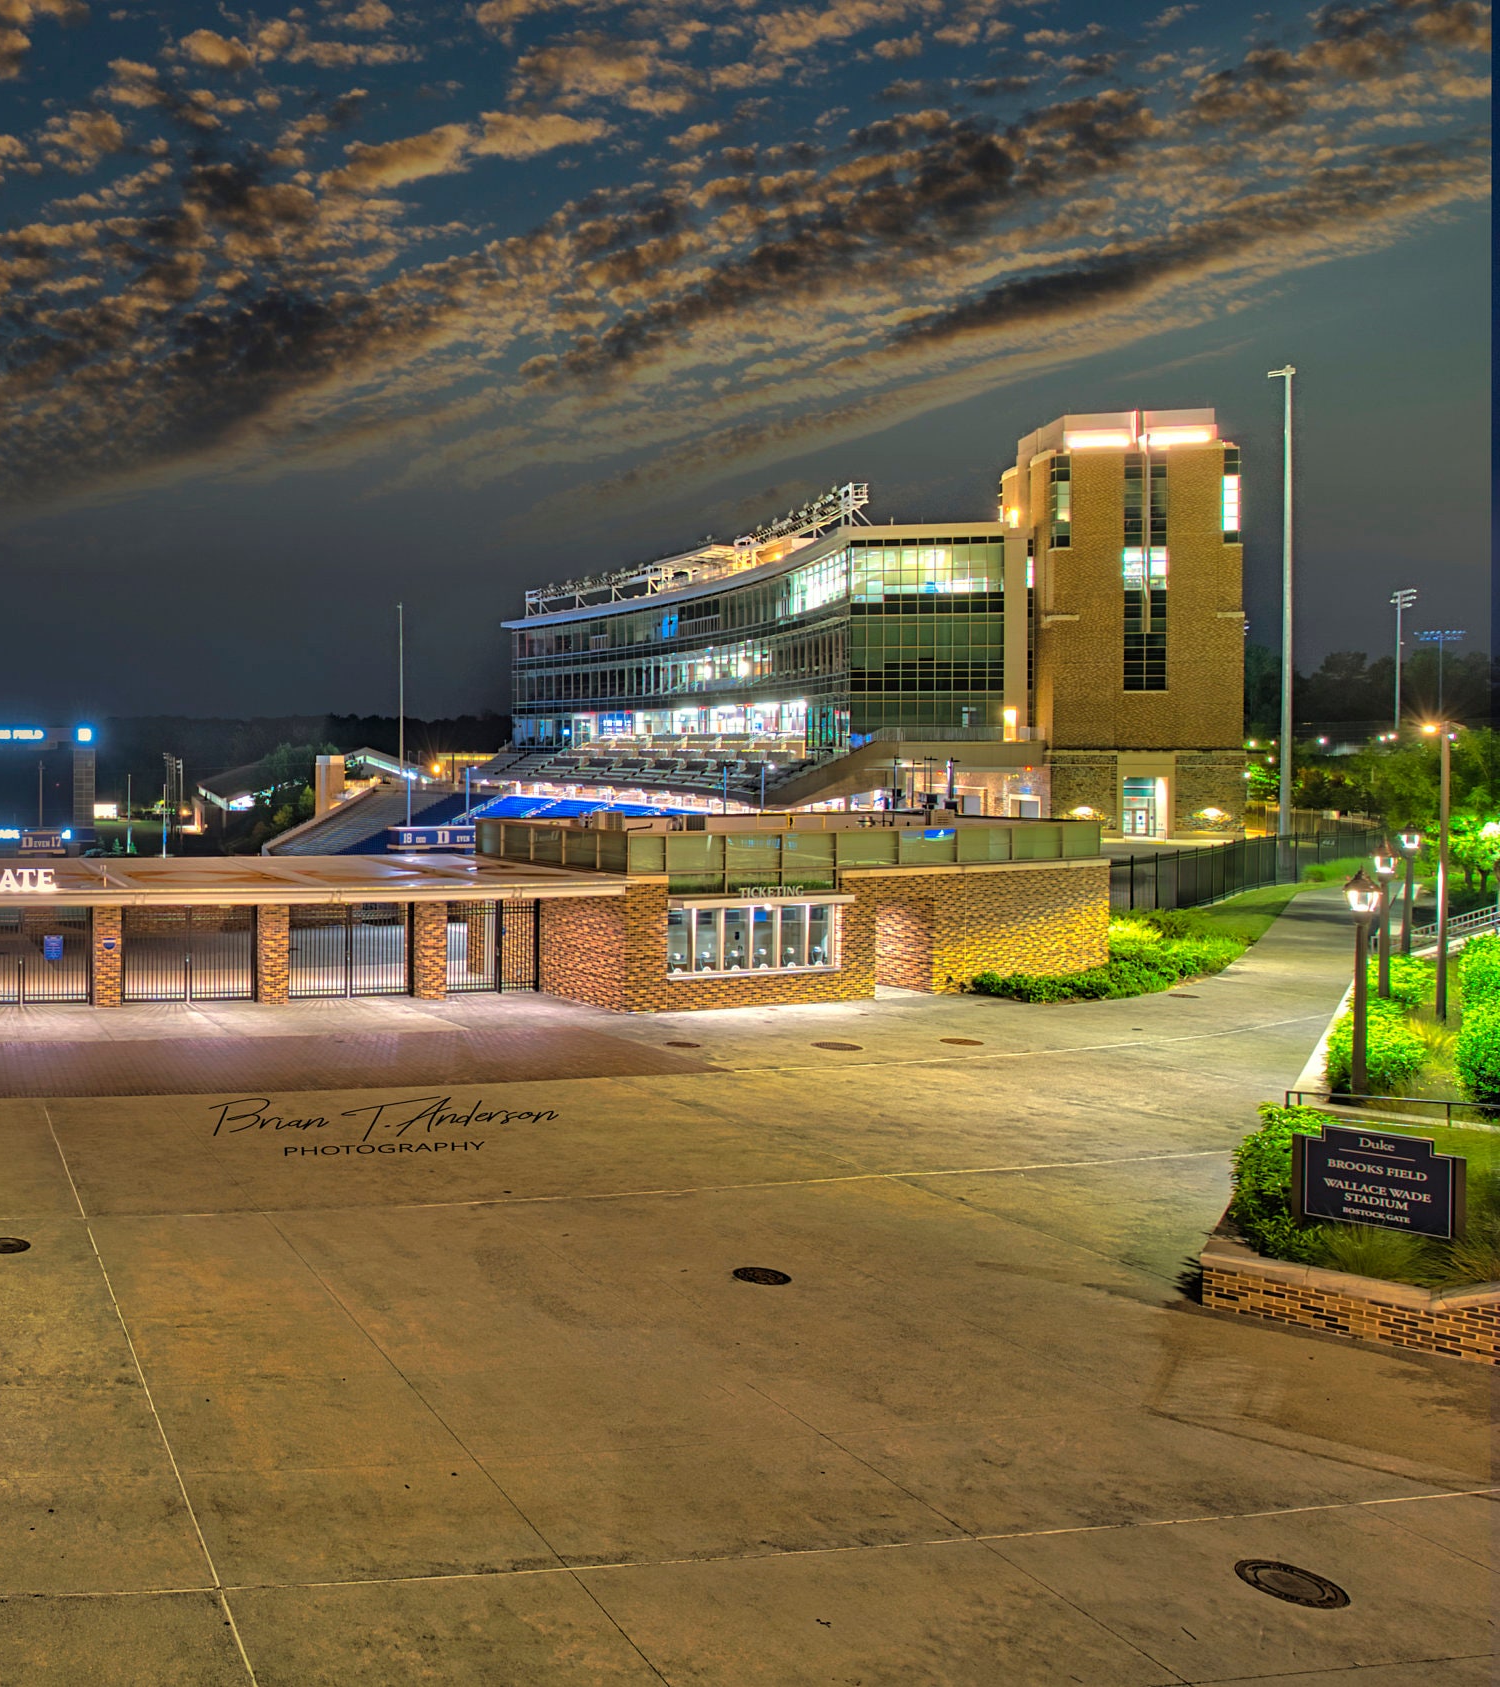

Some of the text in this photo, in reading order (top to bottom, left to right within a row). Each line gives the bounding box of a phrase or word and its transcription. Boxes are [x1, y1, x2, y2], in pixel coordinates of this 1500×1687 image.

[51, 836, 61, 848] 17
[403, 832, 413, 844] 18
[738, 885, 805, 899] TICKETING
[1358, 1136, 1396, 1152] Duke
[1326, 1158, 1428, 1182] BROOKS FIELD
[1323, 1177, 1432, 1204] WALLACE WADE
[1344, 1192, 1409, 1211] STADIUM
[1342, 1206, 1411, 1224] BOSTOCK GATE
